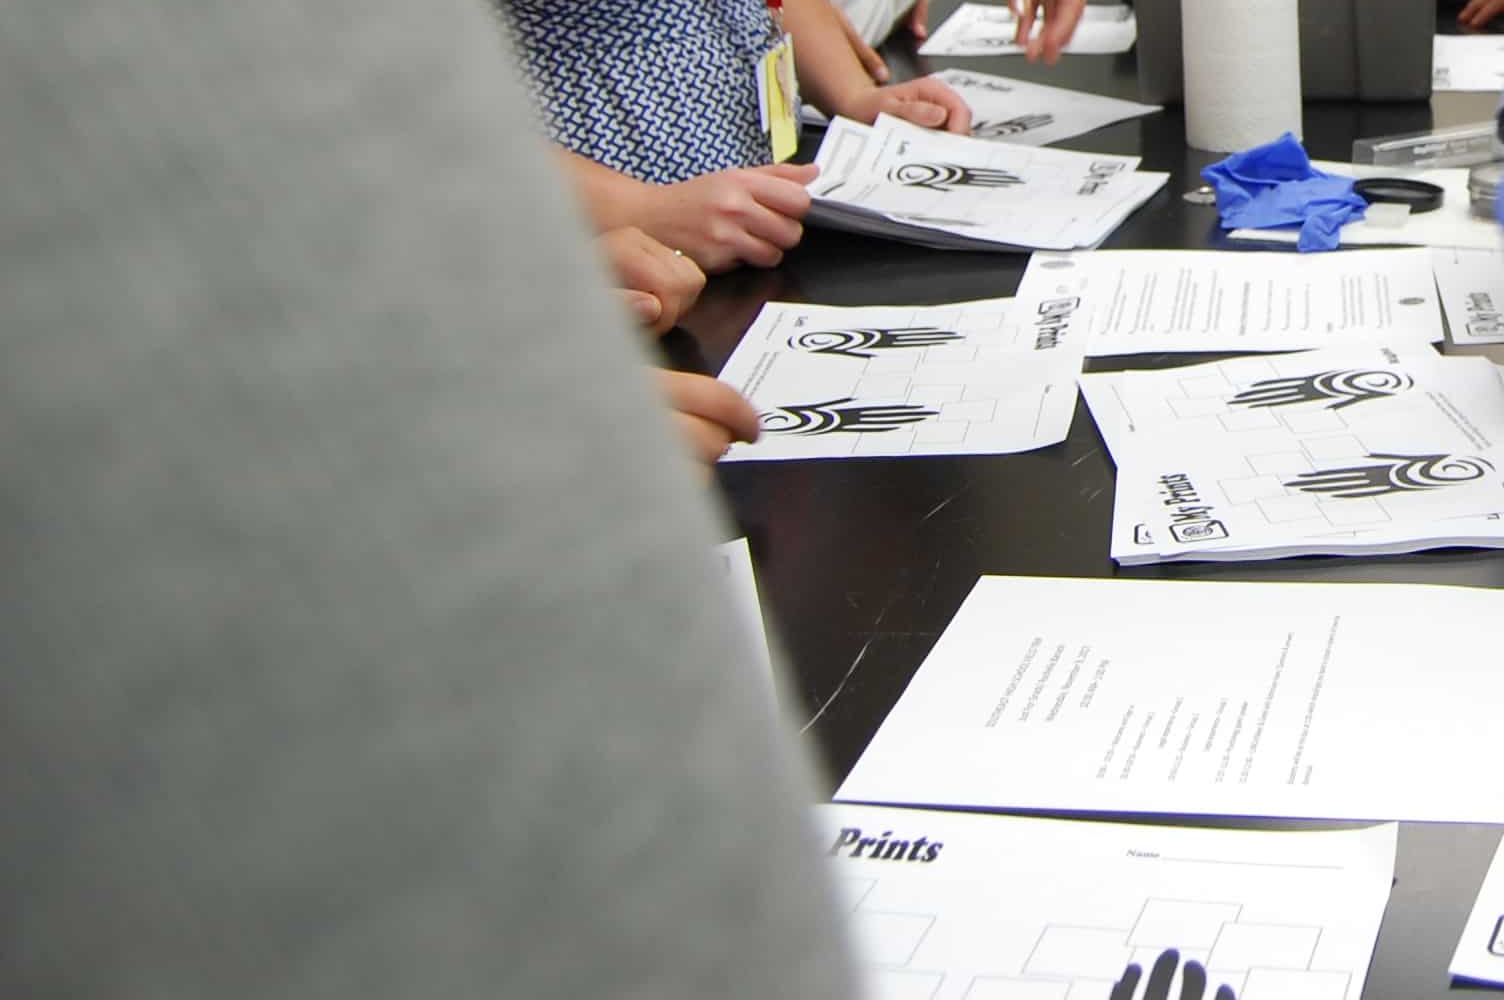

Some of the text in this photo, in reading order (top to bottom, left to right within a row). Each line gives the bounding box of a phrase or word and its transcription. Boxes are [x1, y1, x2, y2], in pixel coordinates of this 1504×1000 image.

[1158, 474, 1214, 522] My Prints
[828, 826, 944, 864] Prints
